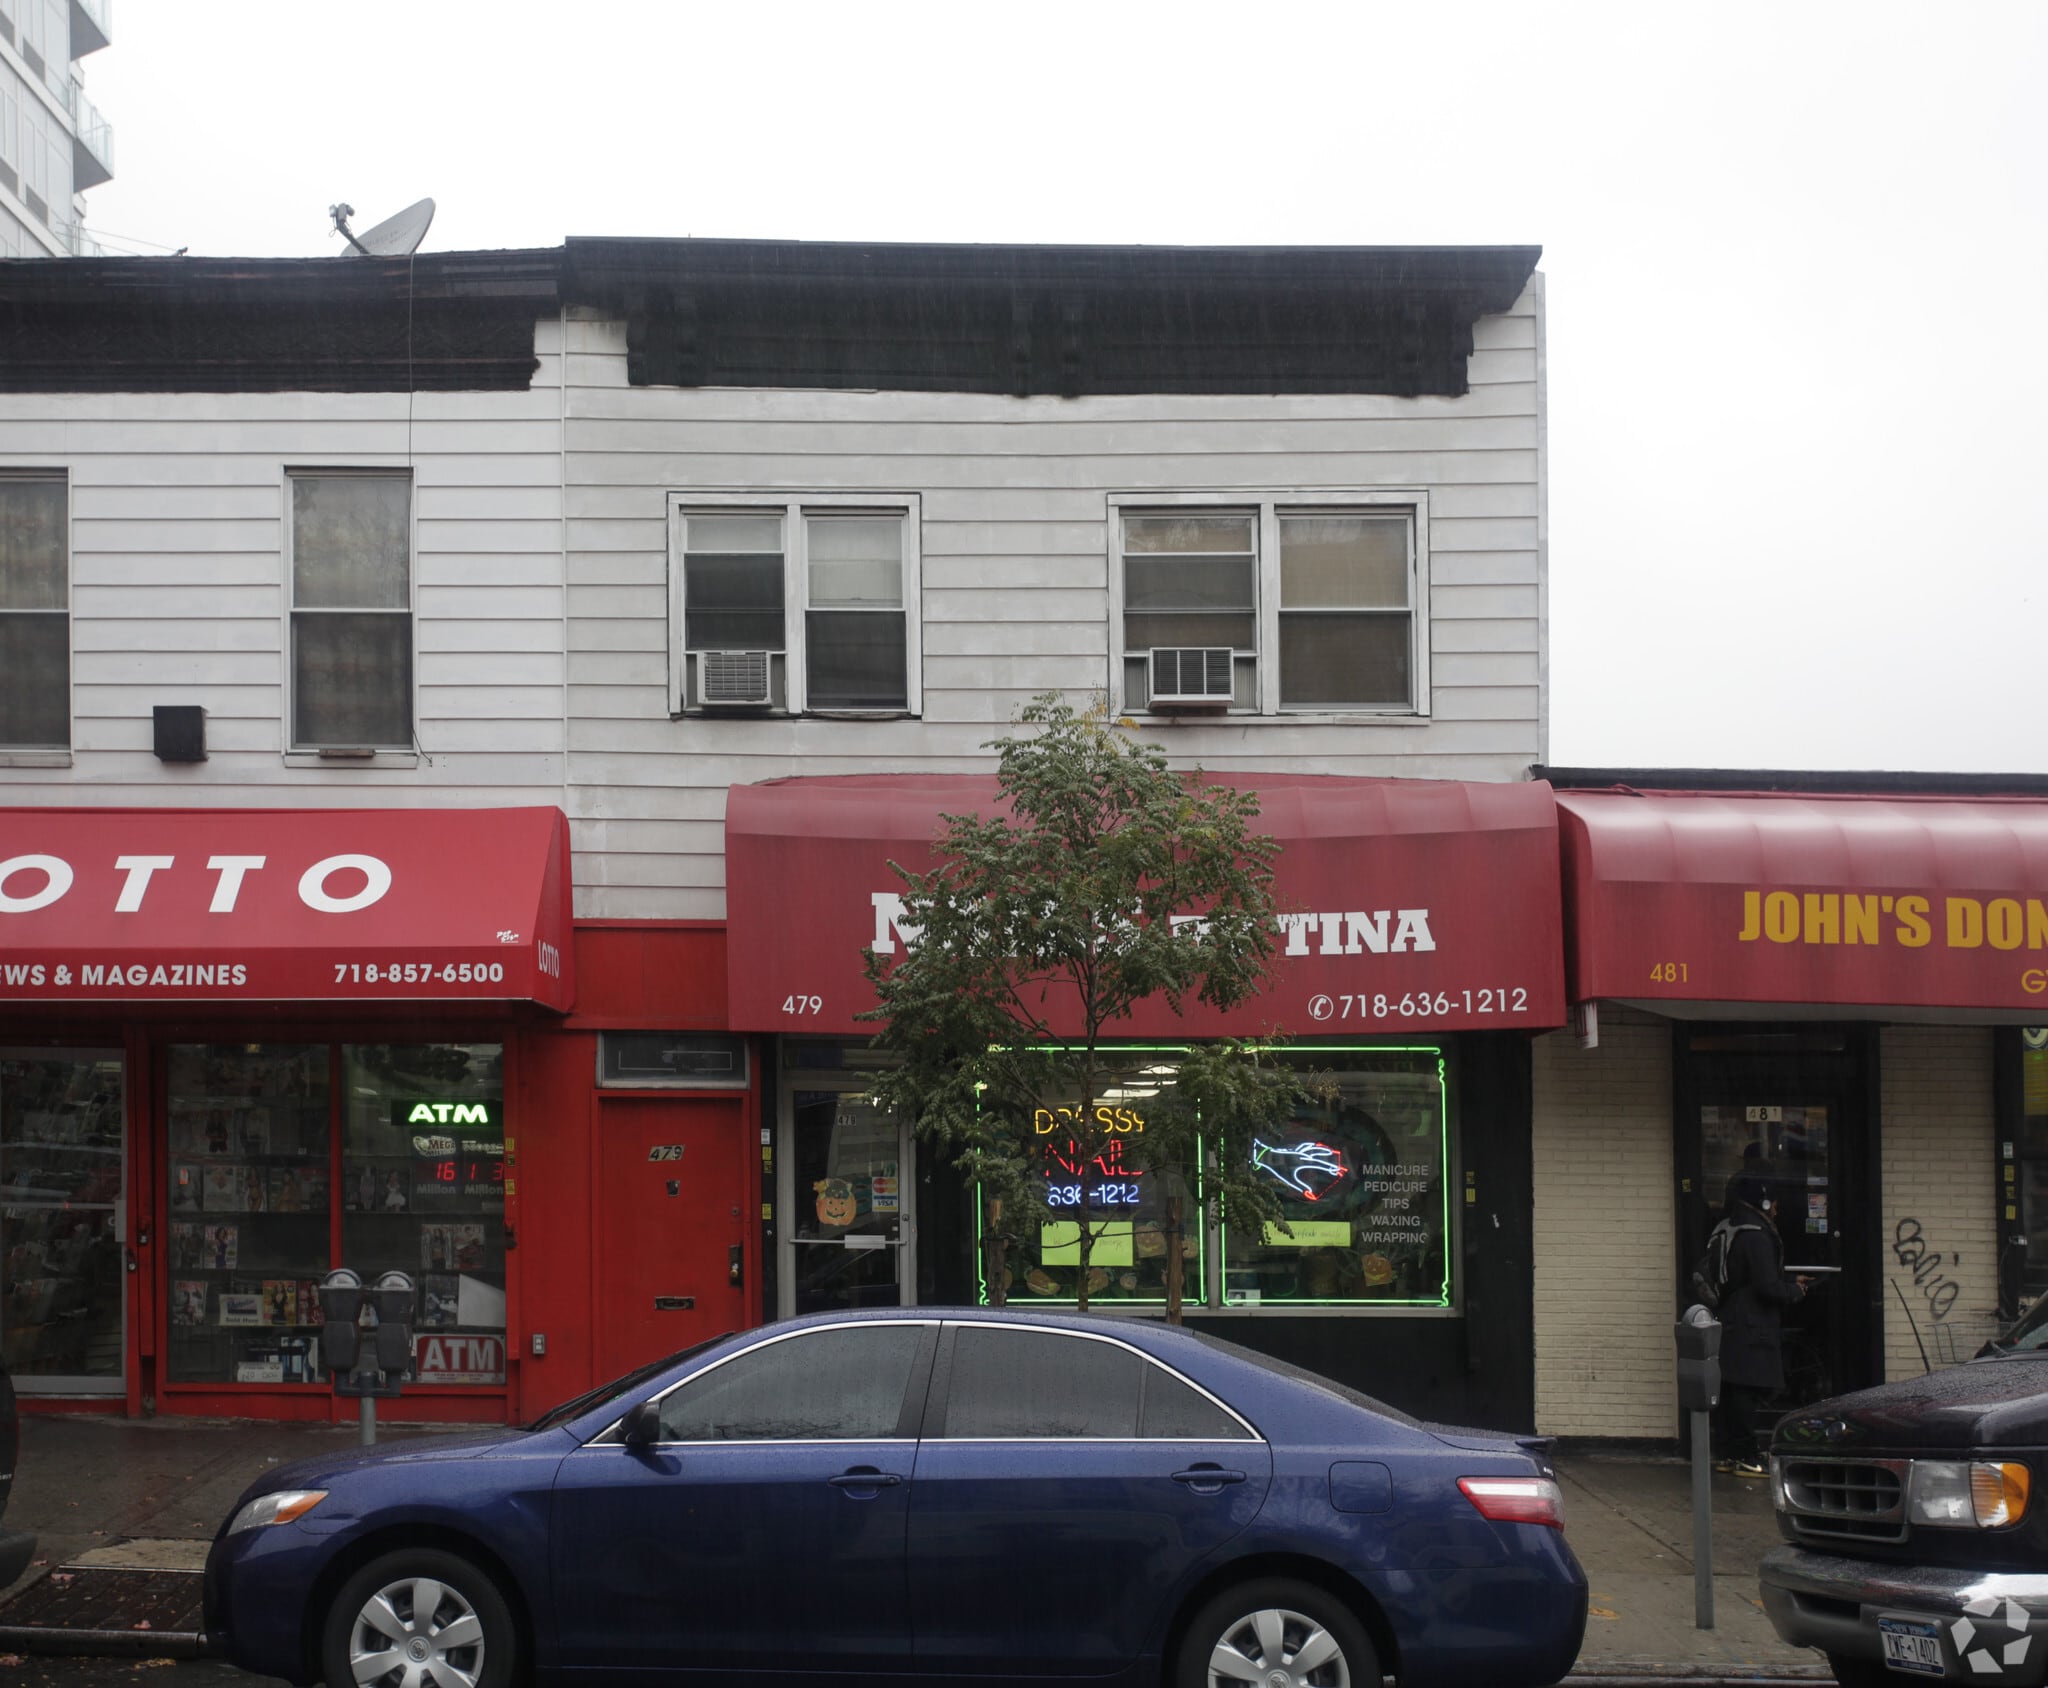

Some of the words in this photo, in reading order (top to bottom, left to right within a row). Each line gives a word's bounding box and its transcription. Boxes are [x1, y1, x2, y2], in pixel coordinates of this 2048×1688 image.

[1739, 891, 1932, 948] JOHN'S
[538, 939, 560, 979] LOTTO
[0, 964, 46, 986] WS
[54, 964, 73, 986] &
[81, 964, 248, 986] MAGAZINES
[334, 963, 504, 984] 718-857-6500
[1650, 962, 1688, 983] 481
[2021, 968, 2048, 994] G
[782, 996, 823, 1016] 479
[1339, 987, 1528, 1019] 718-636-1212
[408, 1103, 489, 1124] ATM
[839, 1114, 856, 1125] 479
[650, 1146, 682, 1160] 479
[1362, 1165, 1429, 1176] MANICURE
[416, 1183, 456, 1195] Million
[464, 1183, 504, 1195] Million
[1364, 1181, 1428, 1193] PEDICURE
[1382, 1198, 1410, 1210] TIPS
[1371, 1215, 1421, 1227] WAXING
[1362, 1232, 1429, 1244] WRAPPING
[422, 1338, 496, 1372] ATM
